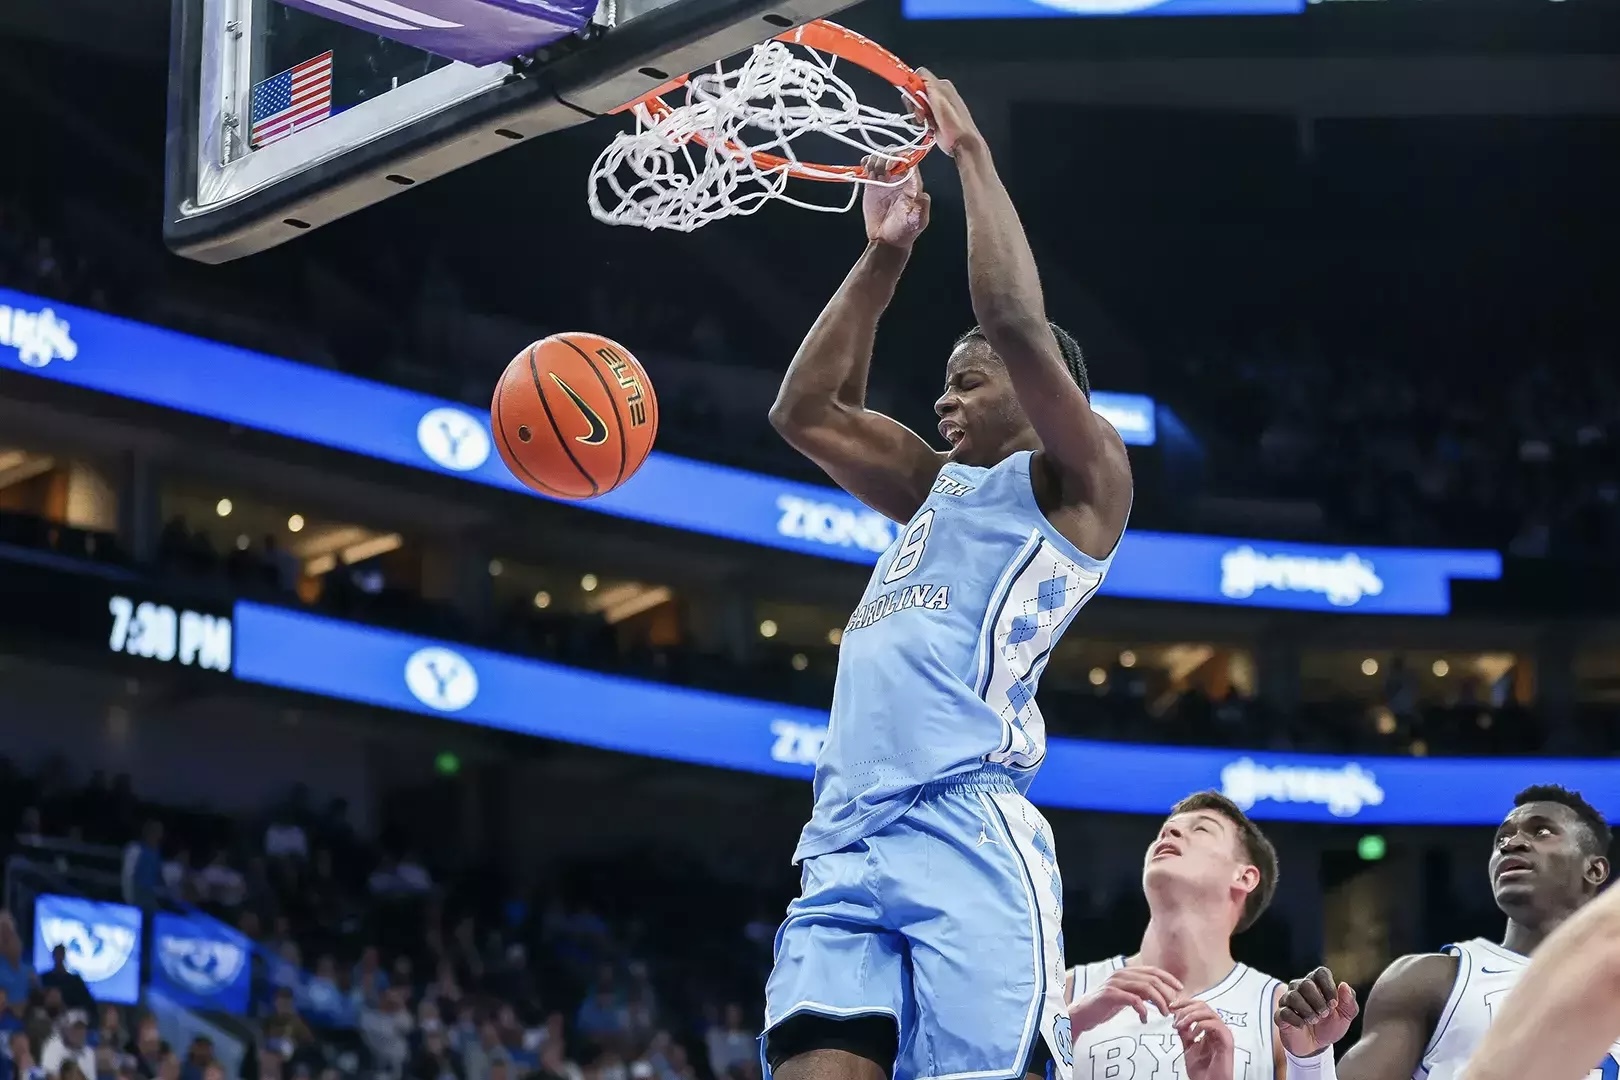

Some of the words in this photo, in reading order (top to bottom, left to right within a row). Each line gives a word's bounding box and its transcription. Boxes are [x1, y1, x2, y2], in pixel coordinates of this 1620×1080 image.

[595, 346, 646, 429] ELITE
[882, 507, 936, 586] 8
[178, 609, 232, 673] PM
[1089, 1033, 1252, 1080] BY
